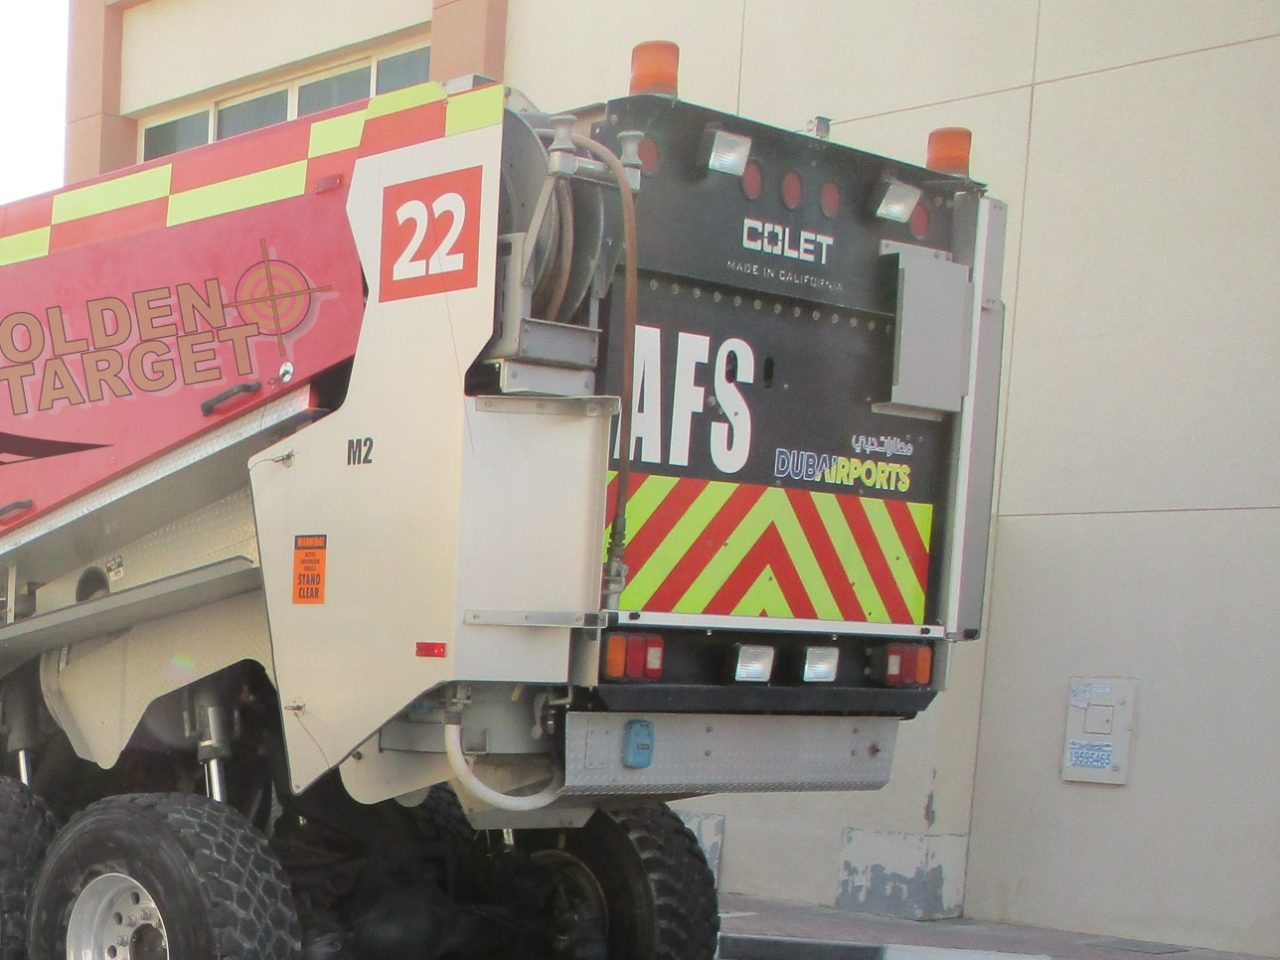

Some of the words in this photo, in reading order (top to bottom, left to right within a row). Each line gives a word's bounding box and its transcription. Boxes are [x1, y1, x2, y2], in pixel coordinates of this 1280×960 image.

[392, 192, 466, 281] 22
[742, 218, 834, 264] COLET
[727, 261, 759, 276] MADE
[763, 267, 774, 278] IN
[613, 324, 755, 474] AFS
[347, 436, 374, 466] M2
[298, 573, 320, 585] STAND
[298, 587, 319, 598] CLEAR
